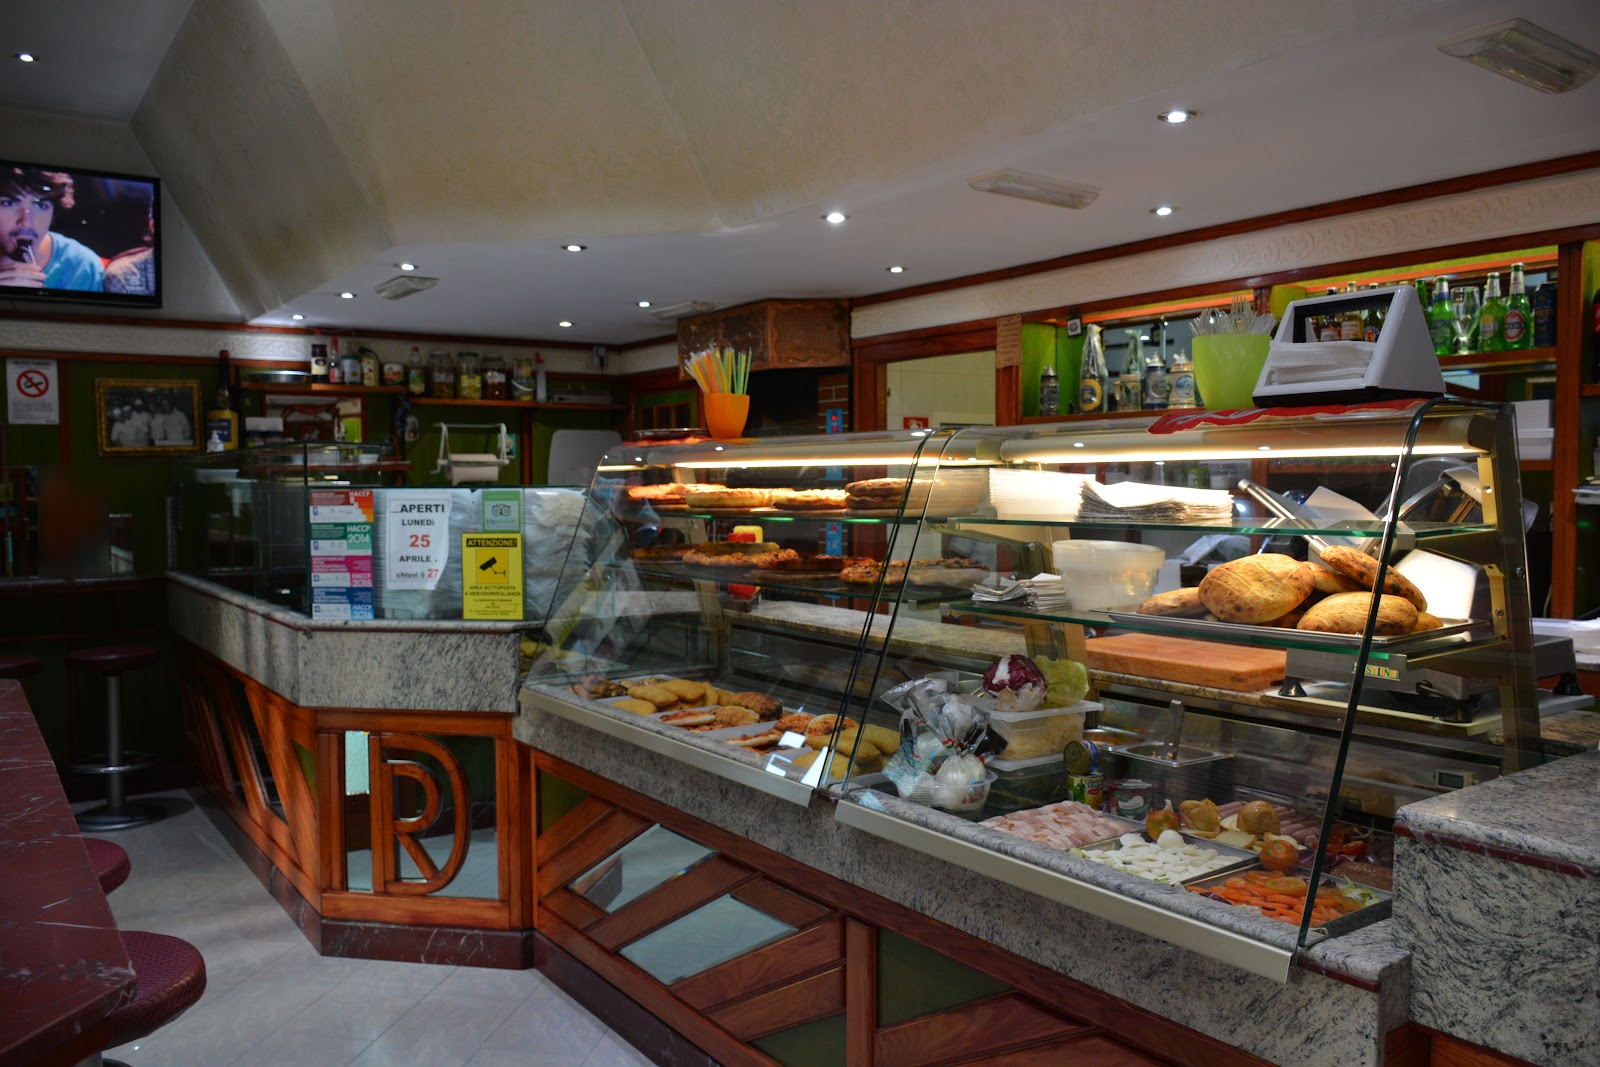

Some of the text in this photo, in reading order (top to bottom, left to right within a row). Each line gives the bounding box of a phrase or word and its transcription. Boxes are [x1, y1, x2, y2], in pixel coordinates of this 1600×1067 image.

[400, 504, 445, 513] APERTI
[347, 533, 370, 543] 2014
[409, 534, 430, 548] 25
[467, 539, 517, 547] ATTENZIONE!
[399, 555, 431, 563] APRILE
[427, 568, 439, 579] 27
